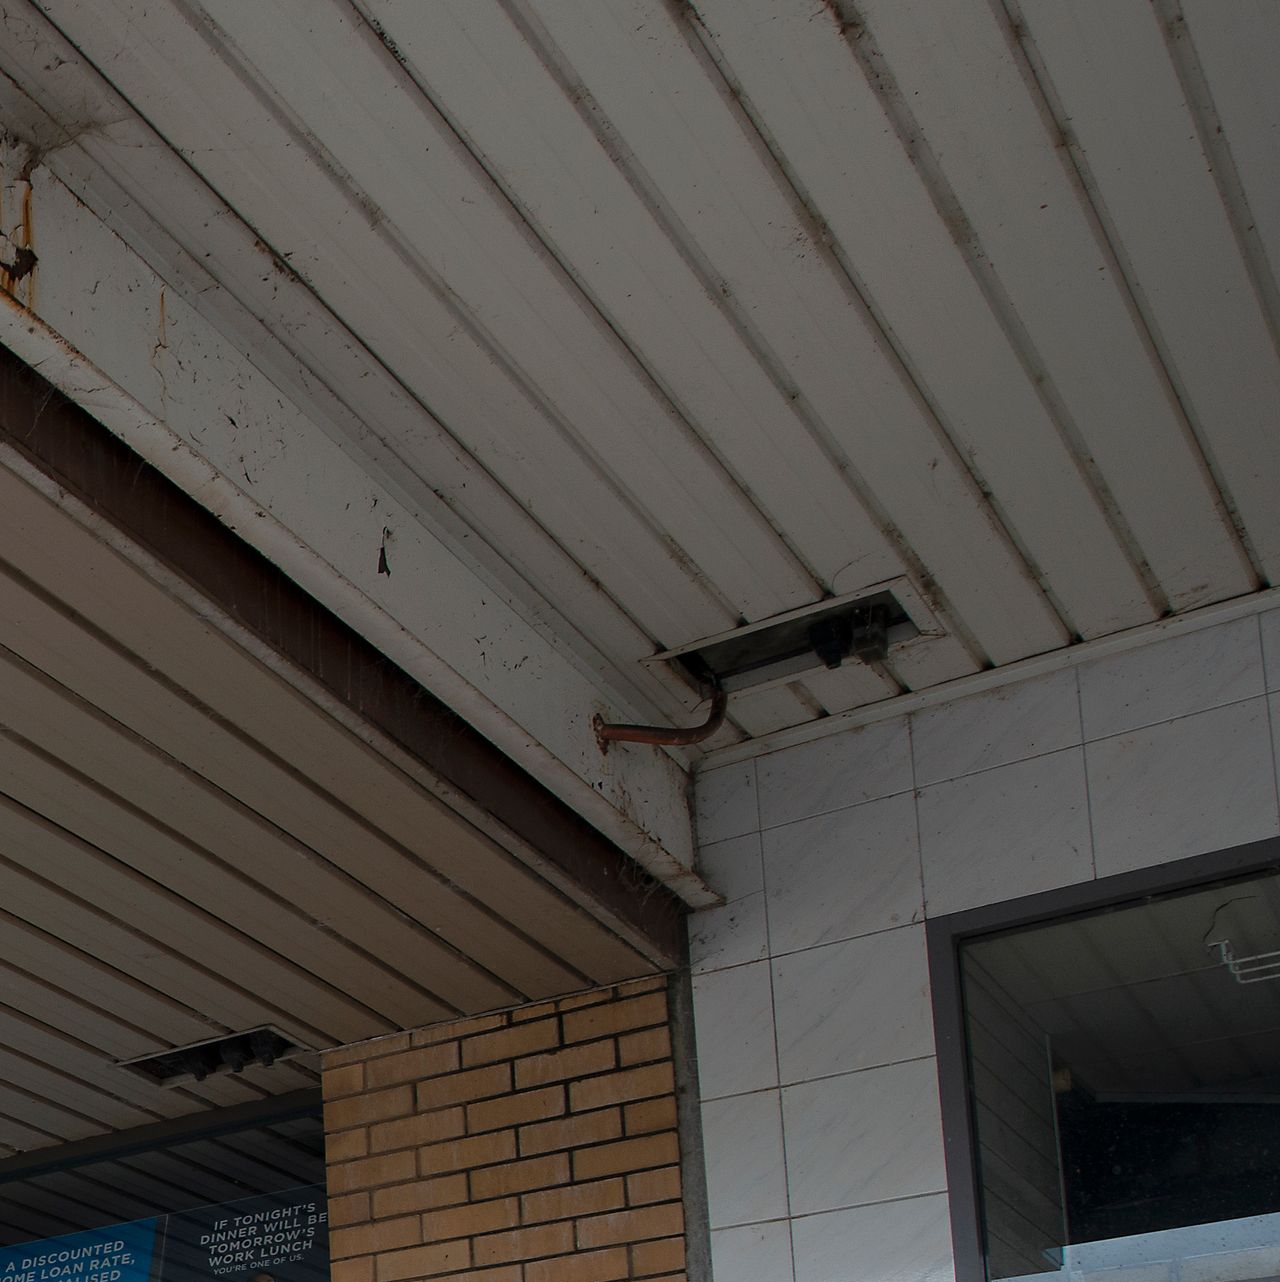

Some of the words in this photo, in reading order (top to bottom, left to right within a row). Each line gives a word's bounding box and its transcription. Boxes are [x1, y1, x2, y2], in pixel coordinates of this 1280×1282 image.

[200, 1226, 258, 1245] DINNER
[264, 1218, 301, 1233] WILL
[308, 1212, 328, 1225] BE
[214, 1219, 228, 1231] IF
[234, 1203, 316, 1227] TONIGHT'S
[209, 1227, 315, 1254] TOMORROW'S
[209, 1250, 255, 1267] WORK
[261, 1240, 313, 1258] LUNCH
[5, 1262, 15, 1273] A
[22, 1241, 125, 1270] DISCOUNTED
[40, 1262, 83, 1280] LOAN
[89, 1253, 135, 1271] RATE,
[213, 1263, 247, 1275] YOU'RE
[250, 1260, 270, 1269] ONE
[273, 1256, 287, 1265] OF
[289, 1254, 304, 1262] US.
